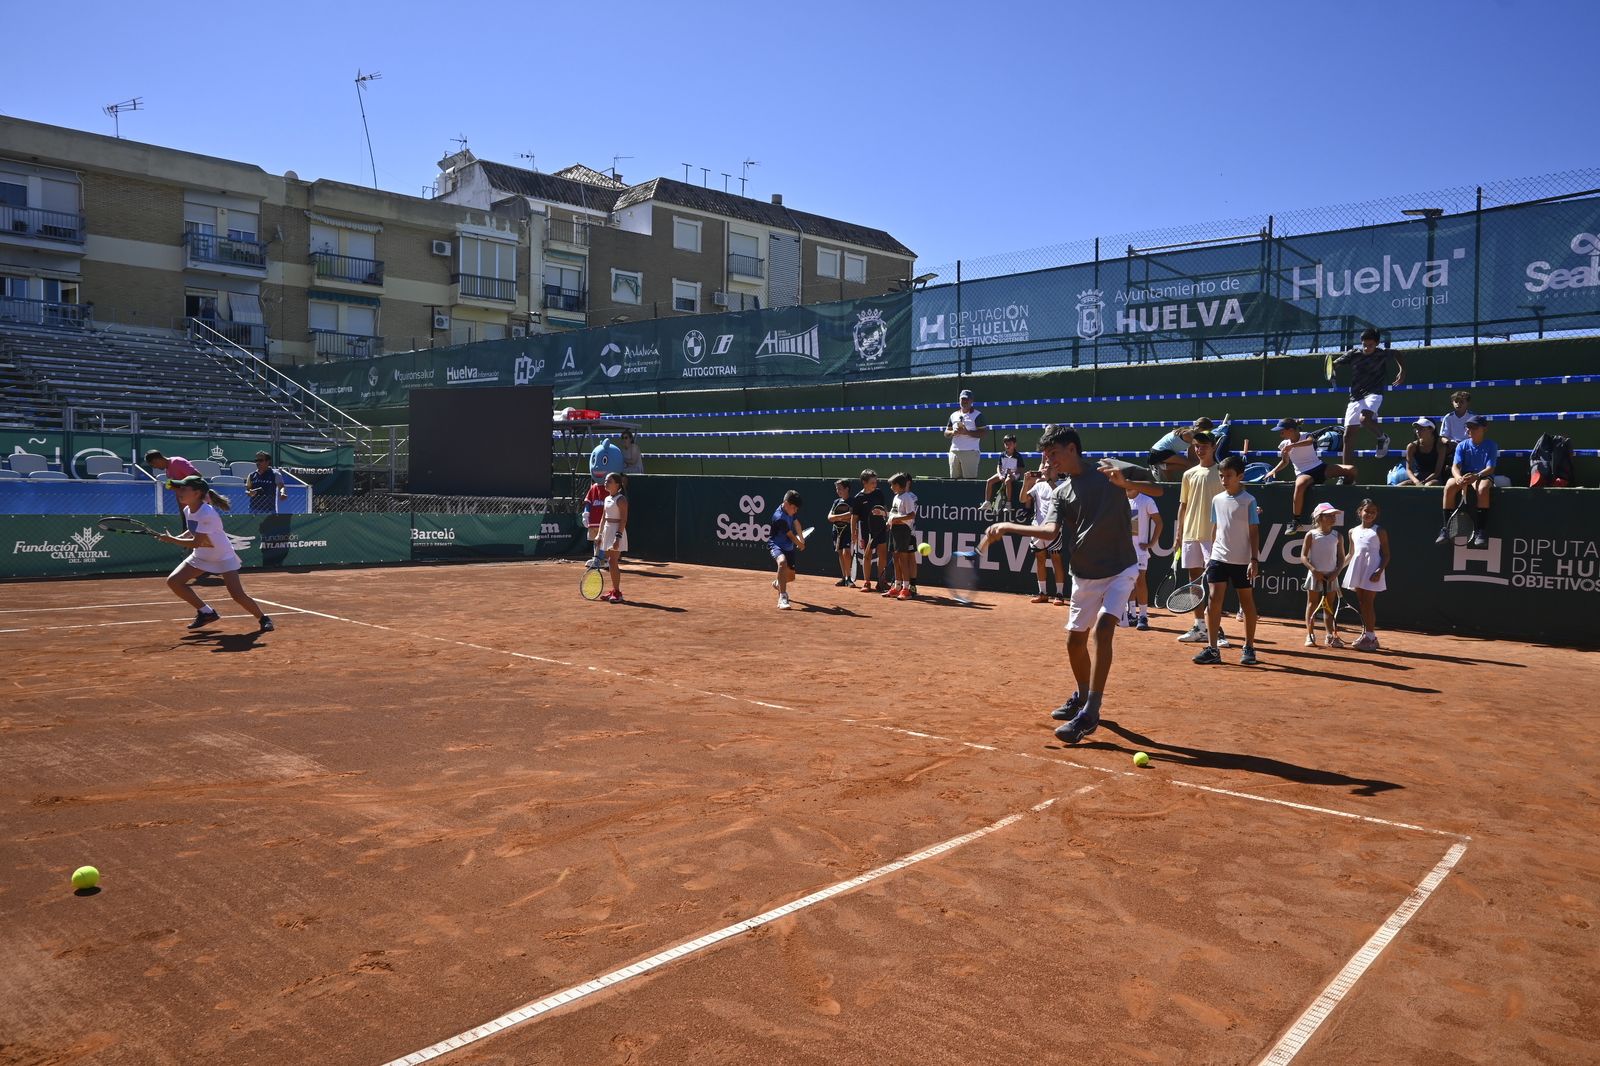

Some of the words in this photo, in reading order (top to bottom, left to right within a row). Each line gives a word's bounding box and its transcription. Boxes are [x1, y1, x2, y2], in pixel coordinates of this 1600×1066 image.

[1293, 255, 1449, 300] Huelva
[1115, 281, 1216, 305] Ayuntamiento
[1220, 276, 1240, 291] de
[1391, 291, 1449, 310] original
[949, 301, 1029, 325] DIPUTACIÓN
[1116, 299, 1245, 334] HUELVA
[949, 326, 966, 338] DE
[972, 319, 1028, 335] HUELVA
[950, 335, 999, 347] OBJETIVOS
[446, 365, 478, 380] Huelva
[682, 365, 737, 376] AUTOGOTRAN
[915, 503, 1027, 522] untamiento
[410, 528, 455, 539] Barceló
[717, 514, 772, 542] Seabe
[13, 541, 79, 554] Fundación
[51, 551, 76, 559] CAJA
[1512, 557, 1543, 574] DE
[1557, 559, 1600, 577] HU
[1250, 570, 1308, 594] rigin
